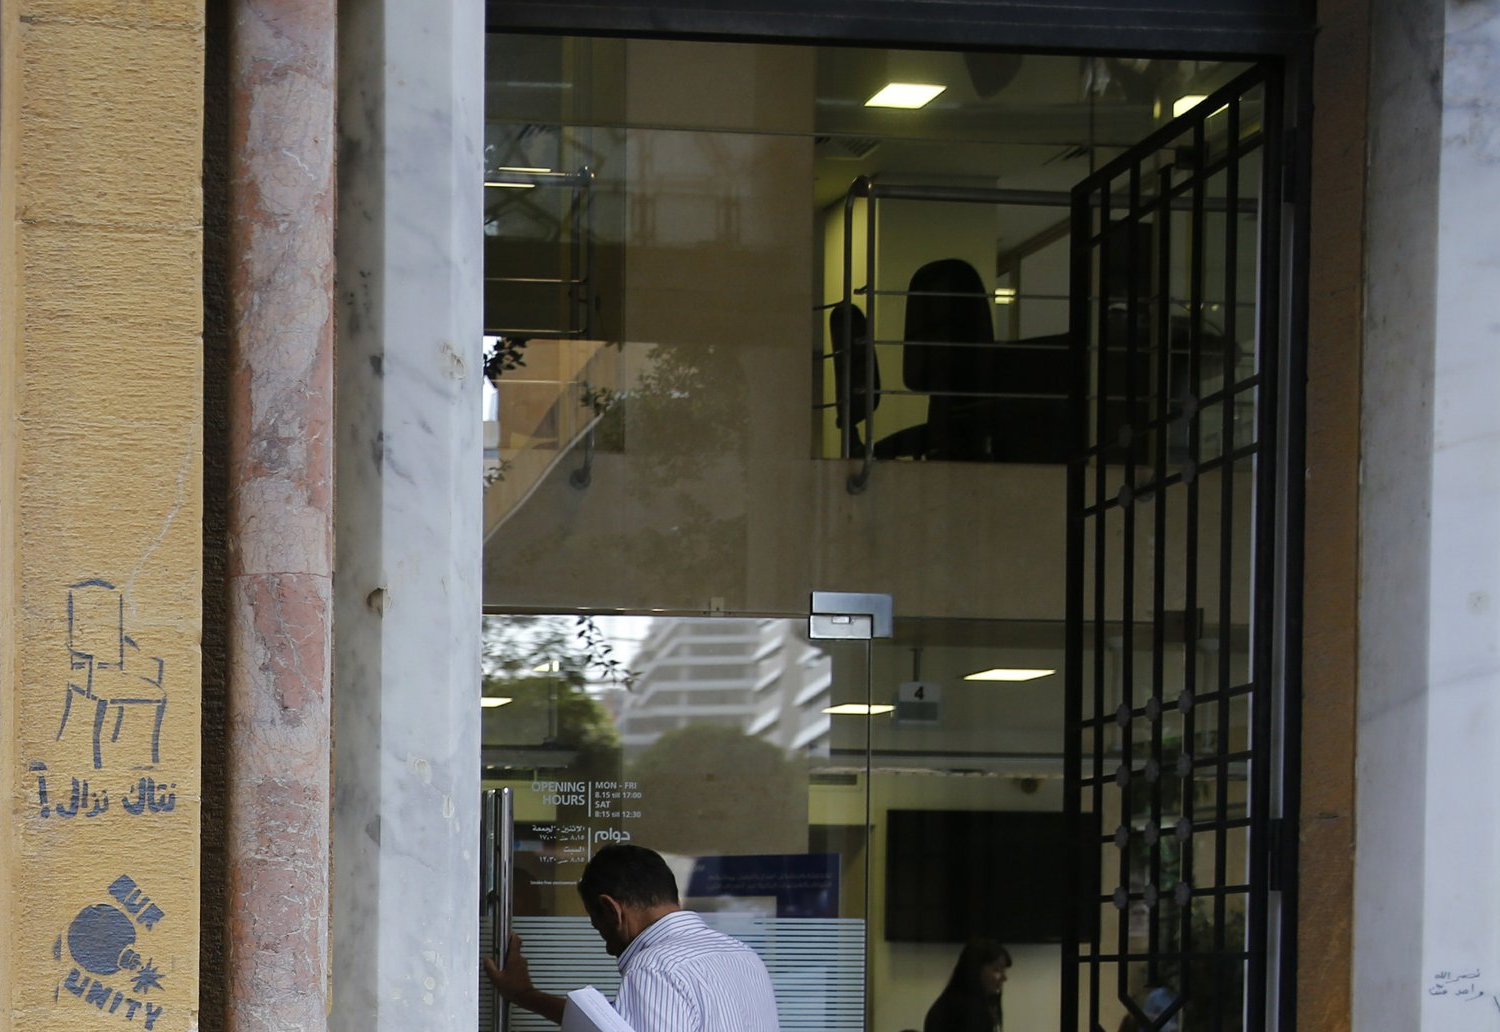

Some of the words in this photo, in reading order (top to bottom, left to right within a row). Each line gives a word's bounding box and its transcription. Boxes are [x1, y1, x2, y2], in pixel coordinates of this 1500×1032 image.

[914, 686, 925, 700] 4
[531, 781, 586, 792] OPENING
[595, 781, 617, 789] MON
[624, 781, 637, 789] FRI
[542, 795, 585, 806] HOURS
[594, 827, 631, 843] دوام
[63, 968, 164, 1031] UNITY
